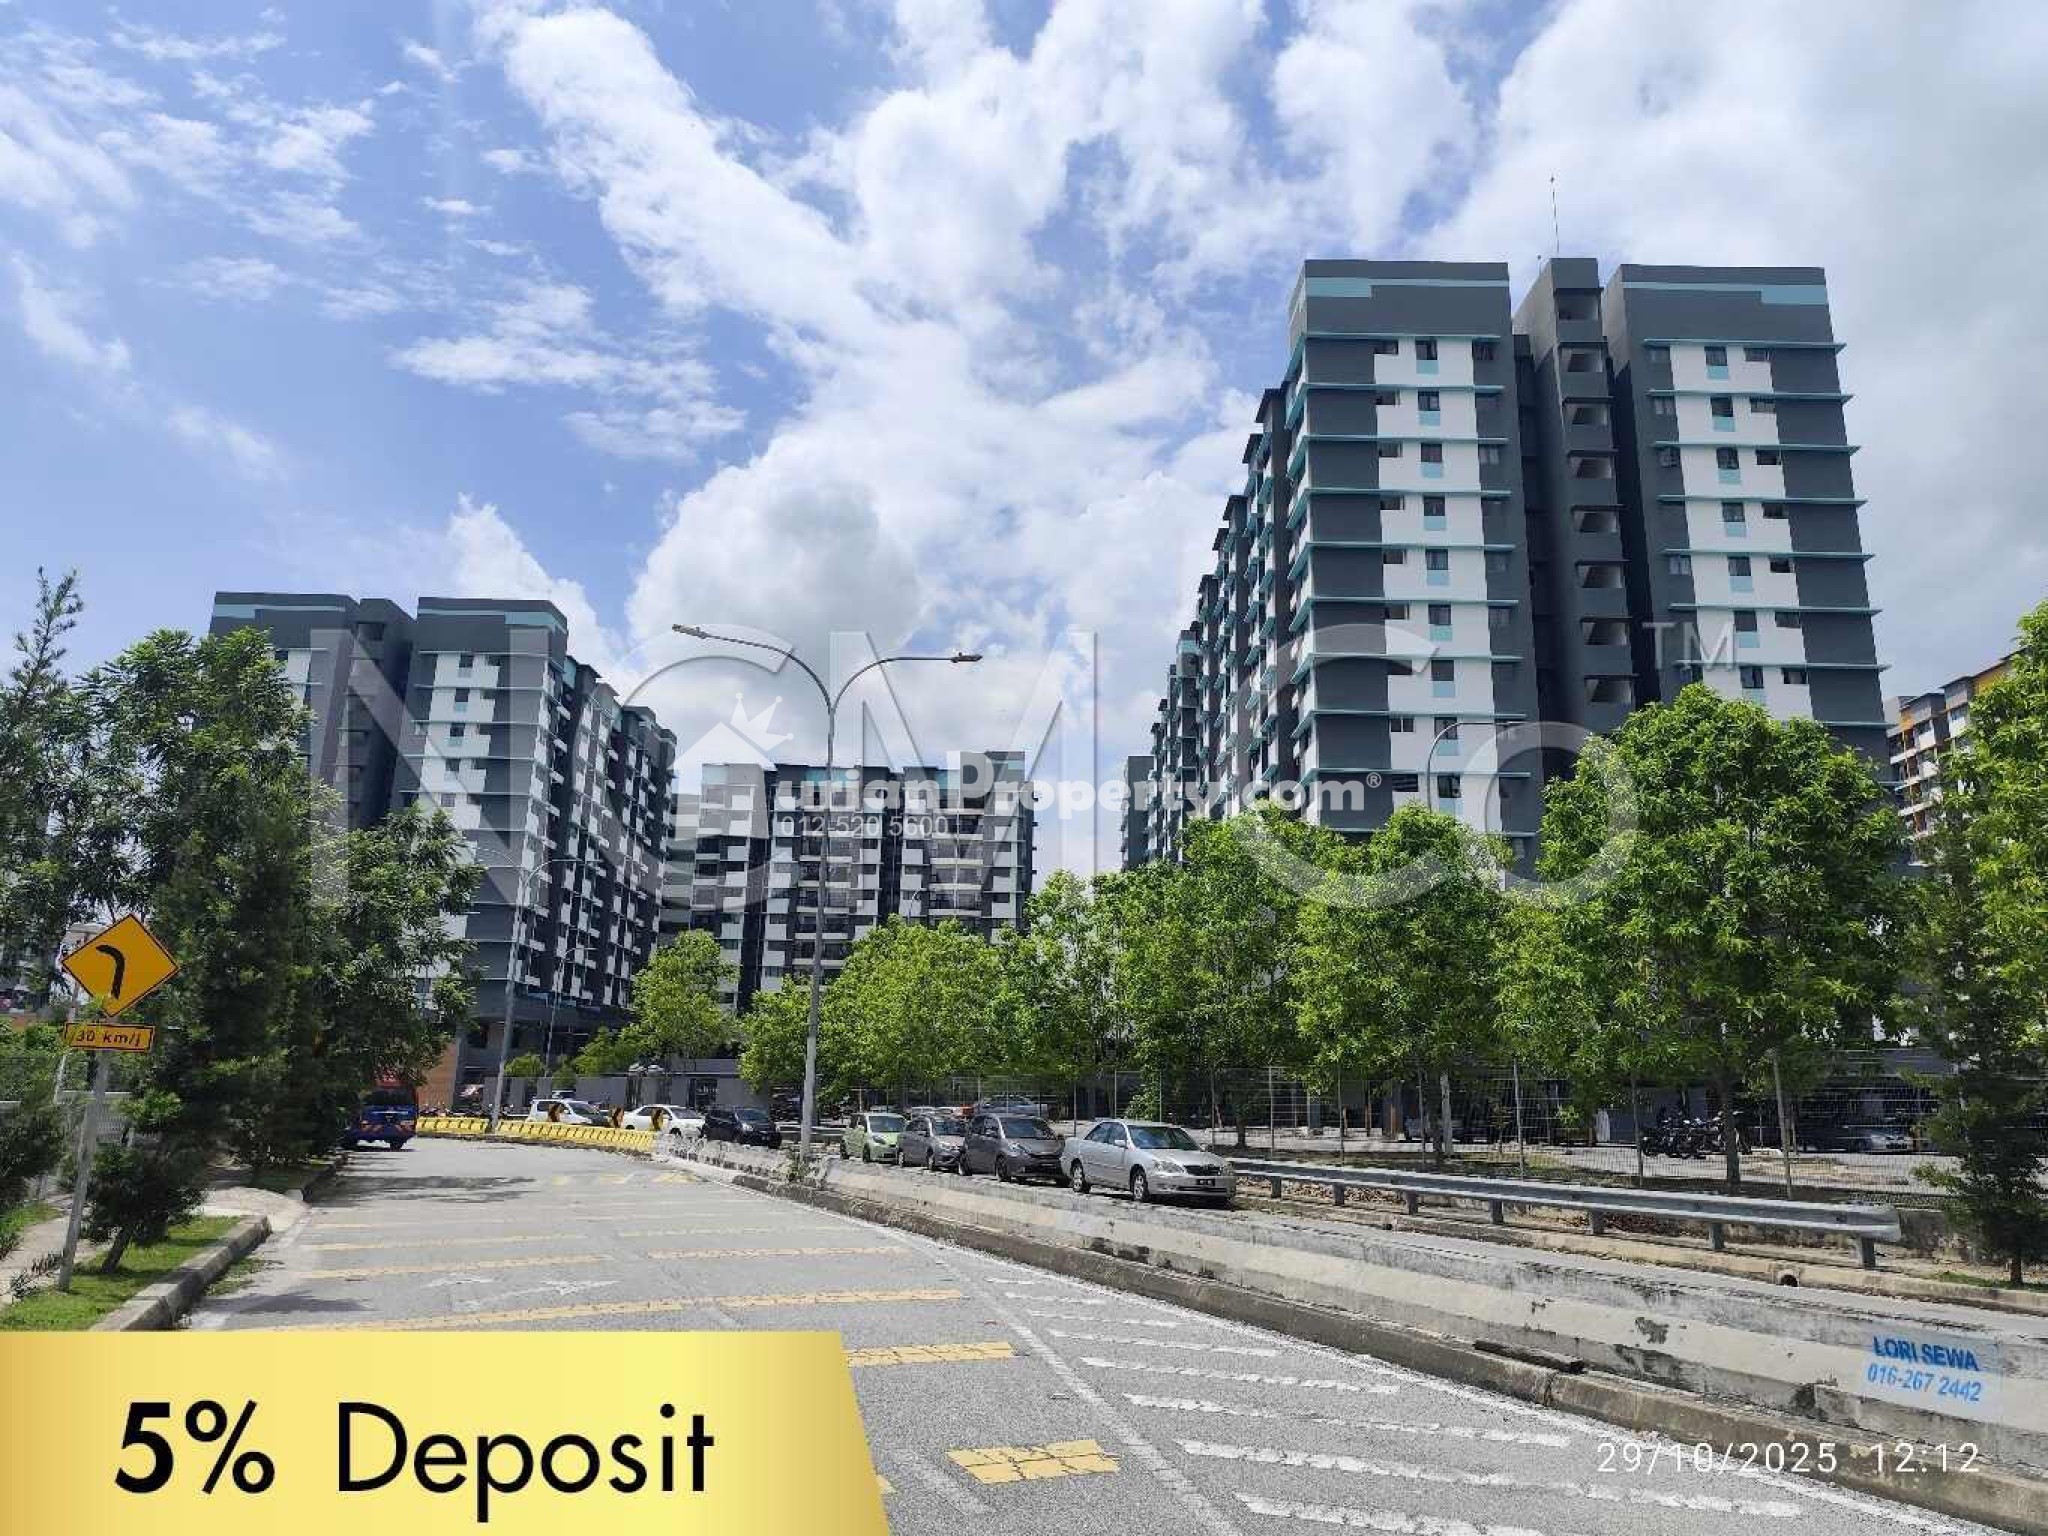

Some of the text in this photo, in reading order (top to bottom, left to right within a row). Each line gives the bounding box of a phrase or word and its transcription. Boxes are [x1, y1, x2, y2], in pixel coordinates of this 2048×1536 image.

[1873, 1336, 1980, 1371] LORI SEWA
[1868, 1362, 1982, 1403] 016-267 2442
